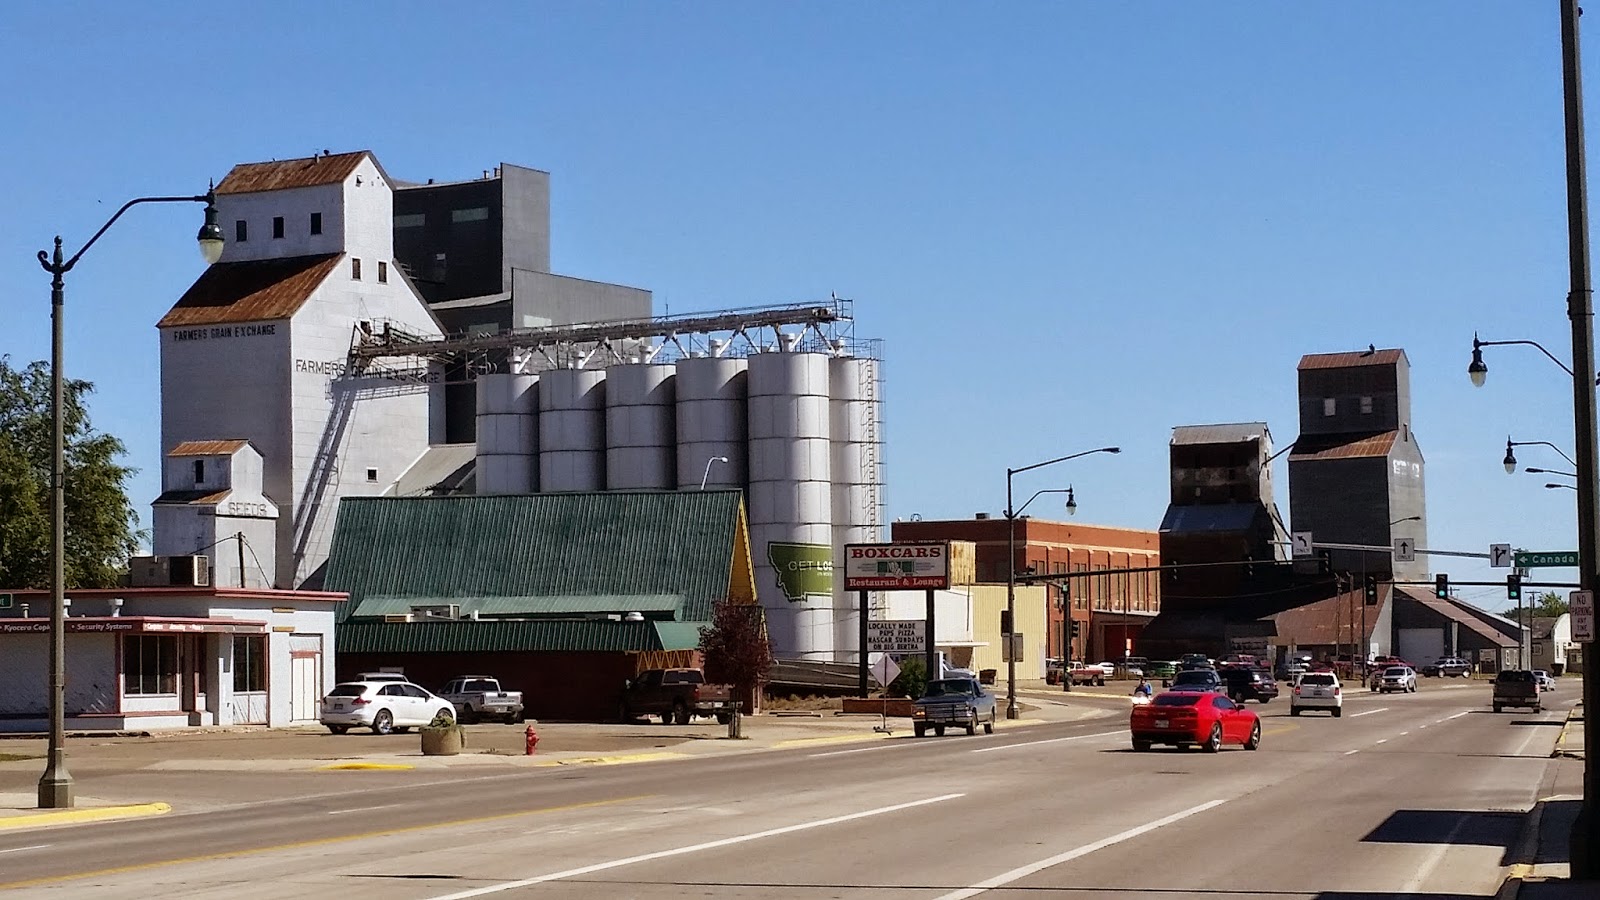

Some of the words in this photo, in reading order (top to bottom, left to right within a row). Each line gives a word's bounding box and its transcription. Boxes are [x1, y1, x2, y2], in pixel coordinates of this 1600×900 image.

[174, 329, 207, 342] FARMERS
[211, 327, 232, 339] GRAIN
[235, 325, 276, 337] EXCHANGE
[296, 359, 346, 377] FARMERS
[228, 502, 267, 516] SEEDS
[851, 547, 941, 559] BOXCARS
[1532, 555, 1575, 564] Canada
[788, 560, 813, 571] GET
[817, 560, 833, 571] LOS
[849, 577, 900, 587] Restaurant
[902, 578, 909, 586] &
[913, 577, 943, 587] Lounge
[1577, 595, 1586, 605] NO
[4, 624, 32, 633] Kyocera
[33, 623, 50, 632] Copi
[77, 623, 104, 632] Security
[105, 623, 132, 632] Systems
